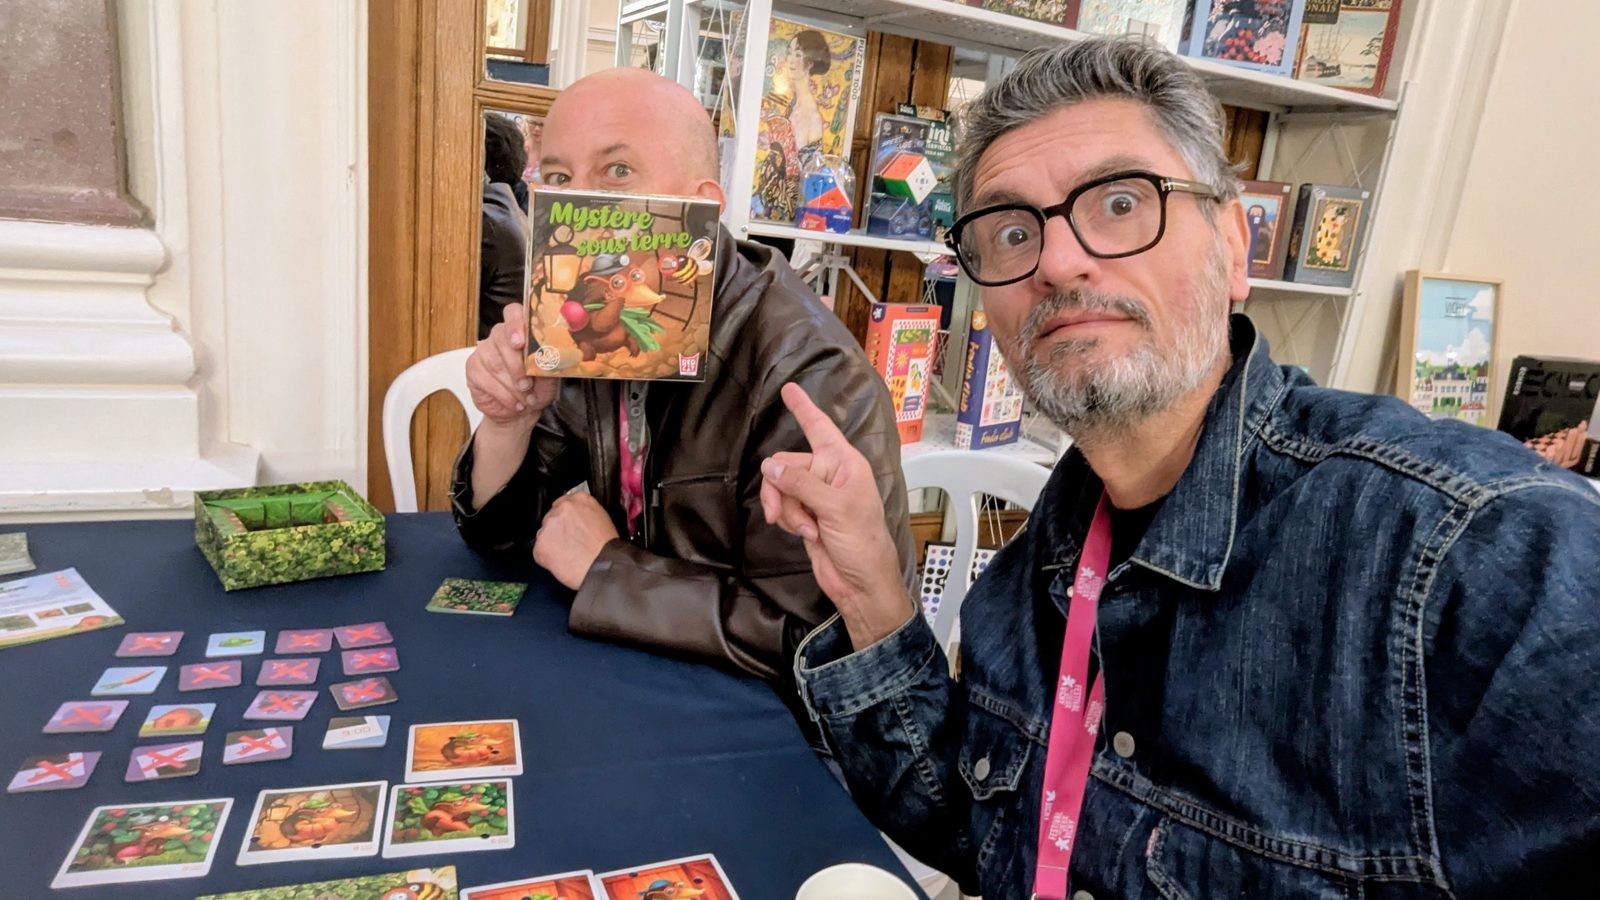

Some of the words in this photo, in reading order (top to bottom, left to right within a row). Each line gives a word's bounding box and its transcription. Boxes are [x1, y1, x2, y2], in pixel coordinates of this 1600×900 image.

[855, 39, 864, 74] PUZZLE
[926, 122, 950, 145] ini
[550, 201, 654, 232] Mystère
[576, 237, 628, 257] sous
[631, 231, 693, 251] terre
[1048, 812, 1063, 841] FESTIVAL
